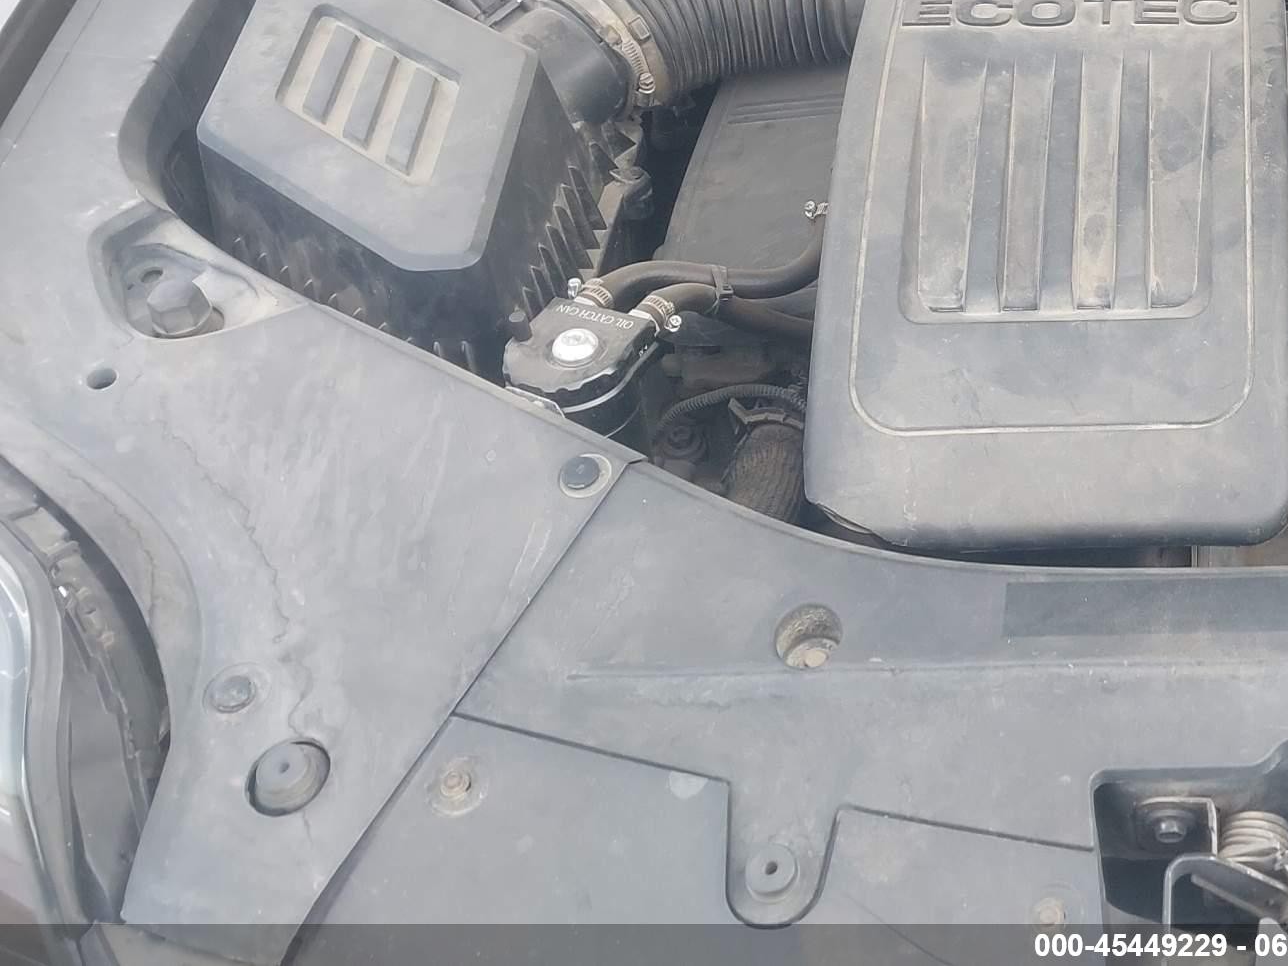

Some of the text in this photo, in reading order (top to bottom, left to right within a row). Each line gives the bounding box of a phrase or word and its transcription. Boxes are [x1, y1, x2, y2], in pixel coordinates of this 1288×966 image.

[557, 304, 634, 330] OIL CATCH CAN
